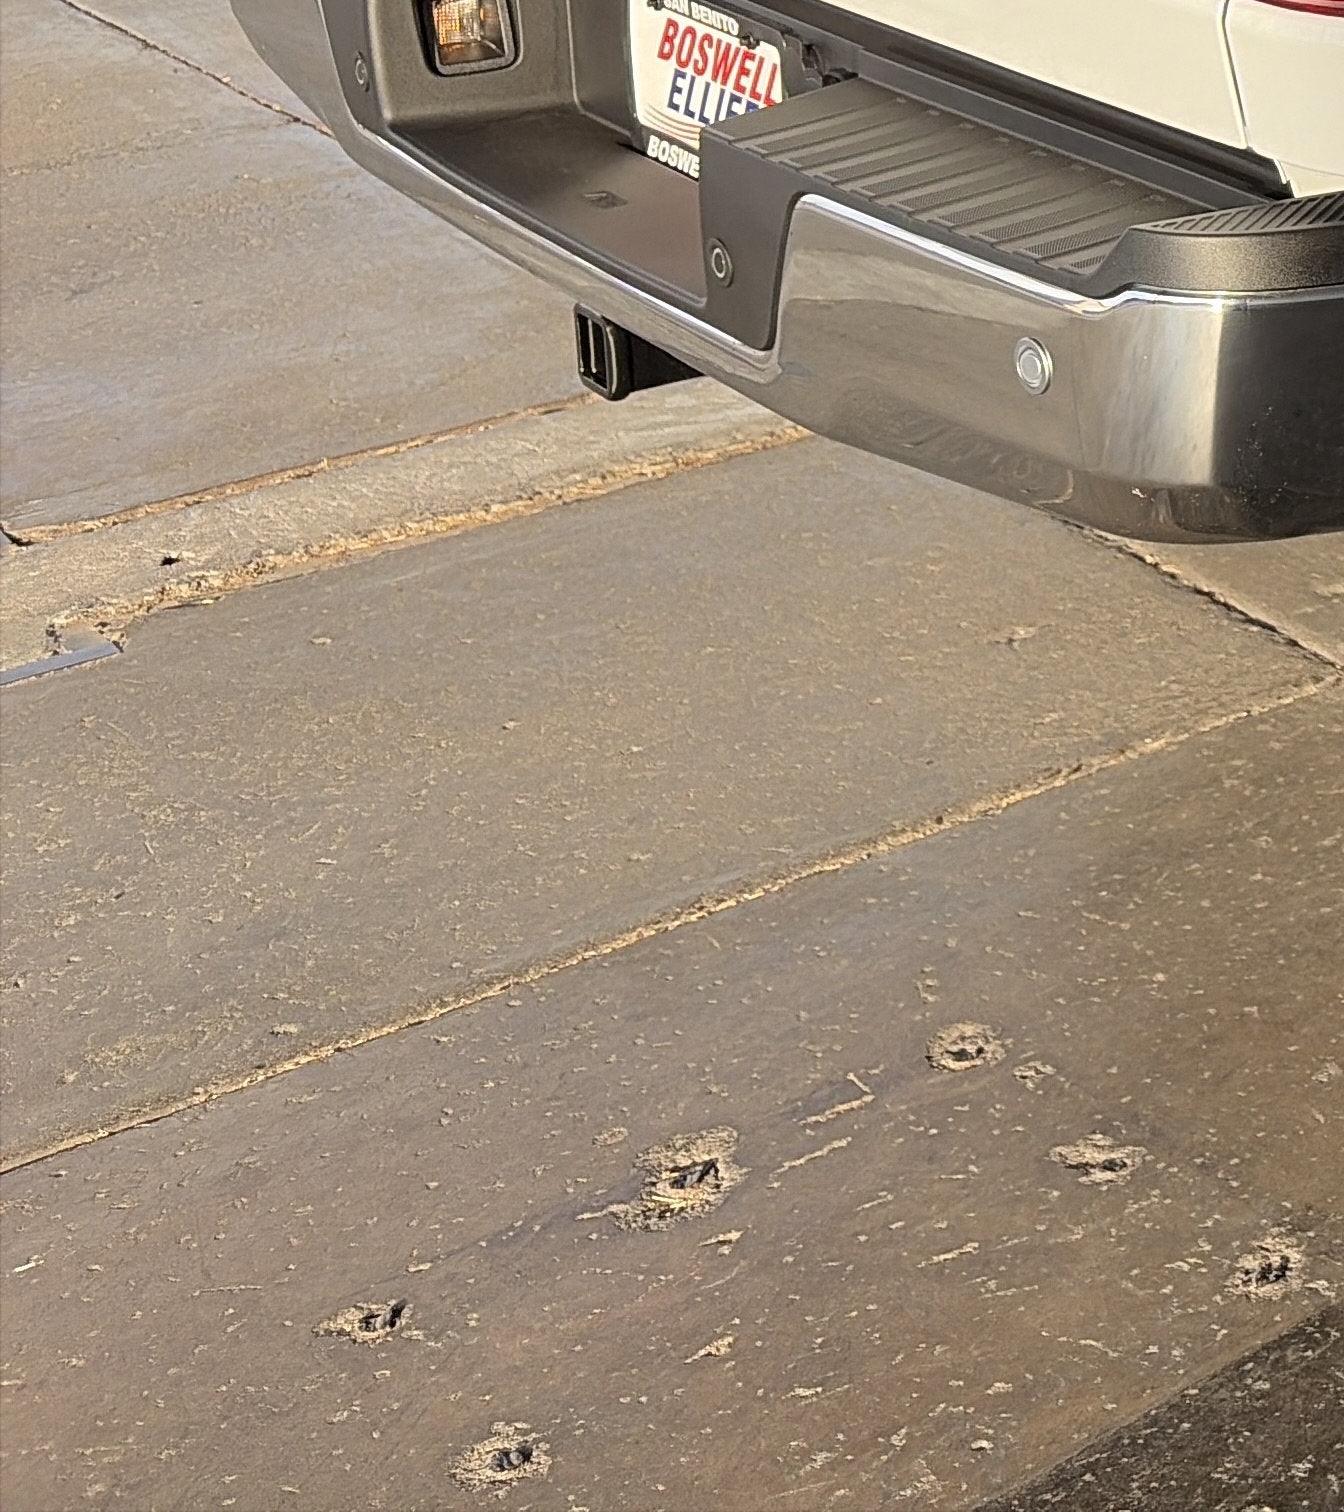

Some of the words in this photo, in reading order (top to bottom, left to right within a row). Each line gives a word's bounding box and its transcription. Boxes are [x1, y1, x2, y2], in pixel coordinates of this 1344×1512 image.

[691, 1, 739, 35] BENITO
[657, 18, 778, 107] BOSWELL
[646, 134, 701, 179] BOSWE
